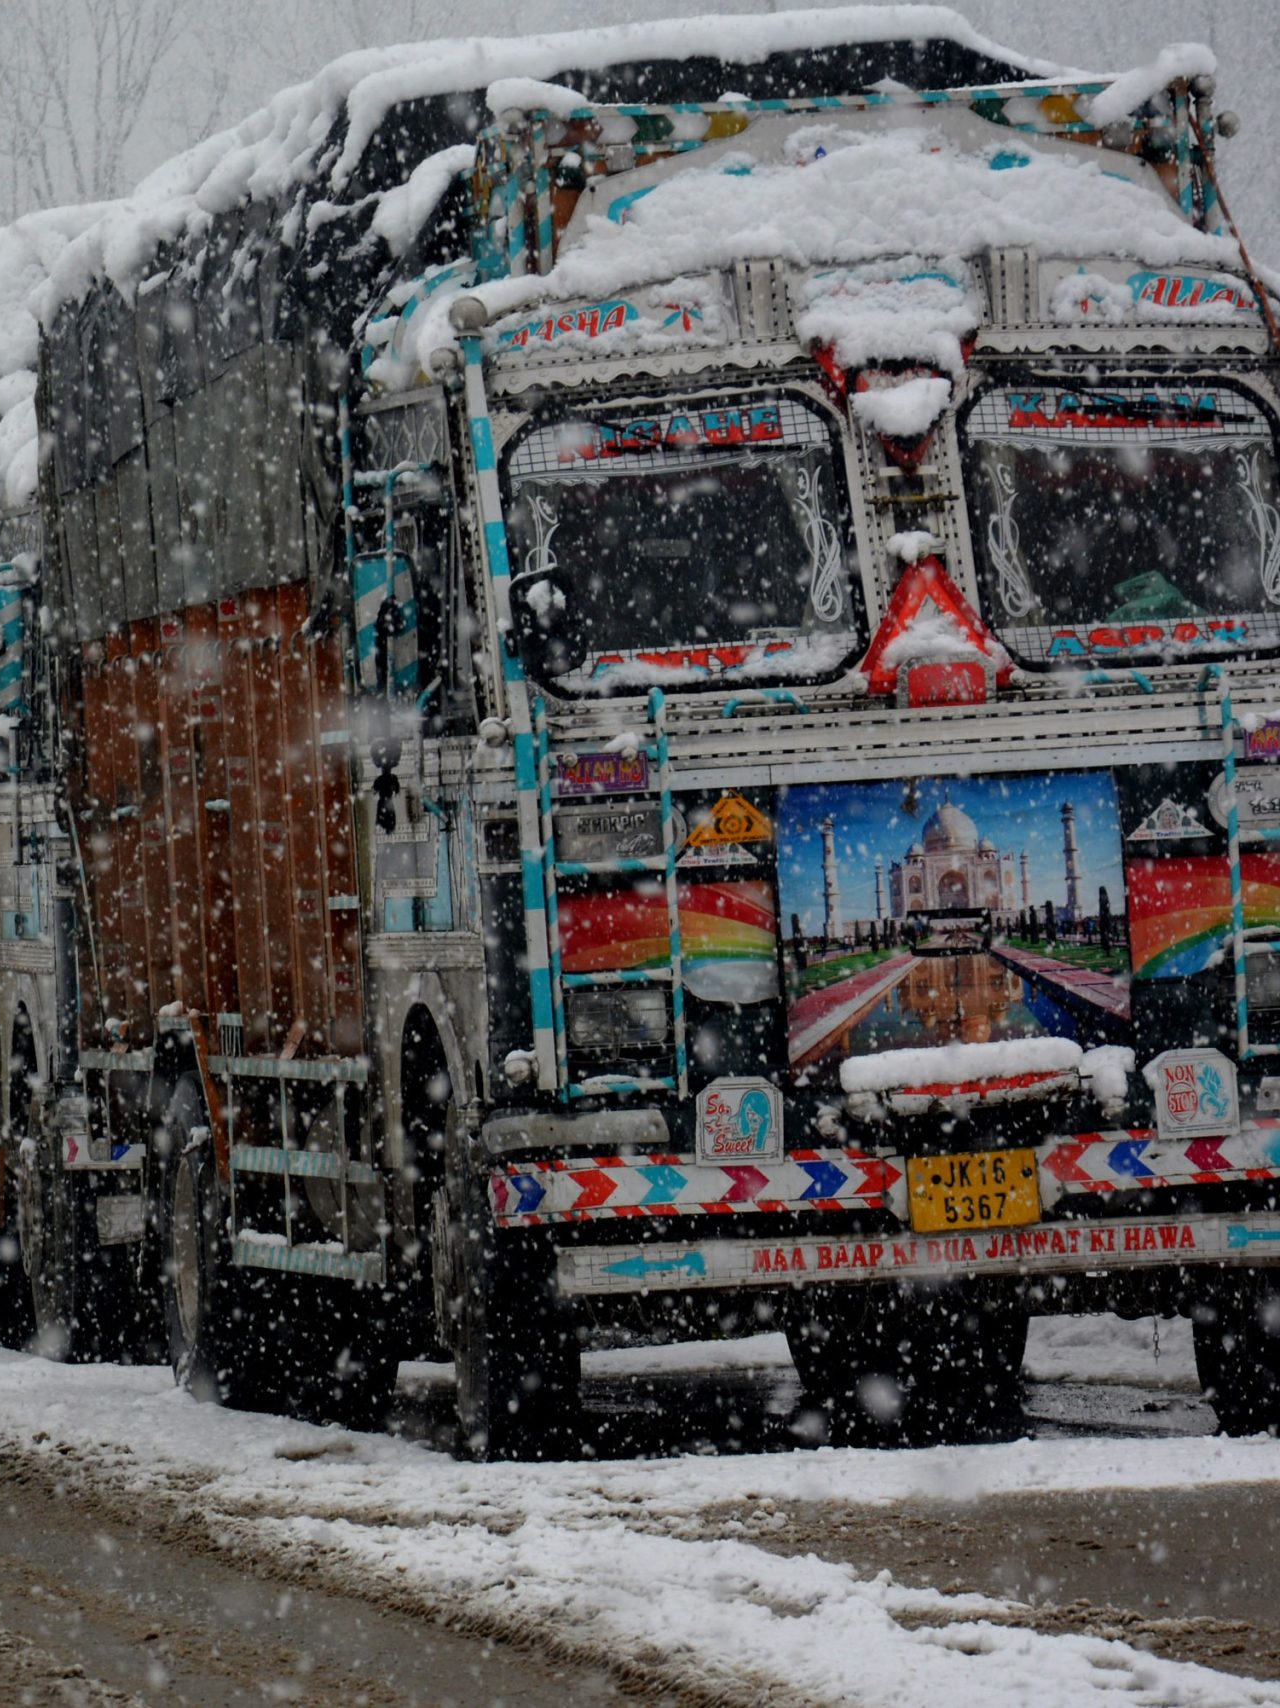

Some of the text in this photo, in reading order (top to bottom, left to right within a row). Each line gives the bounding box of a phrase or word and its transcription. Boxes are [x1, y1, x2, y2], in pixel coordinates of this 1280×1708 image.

[511, 304, 625, 347] MASHA
[1164, 1065, 1196, 1090] NON
[713, 1134, 754, 1153] Sweet
[944, 1192, 1006, 1223] 5367
[752, 1224, 1197, 1273] MAA BAAP KI DUA JANNAT KI HAWA
